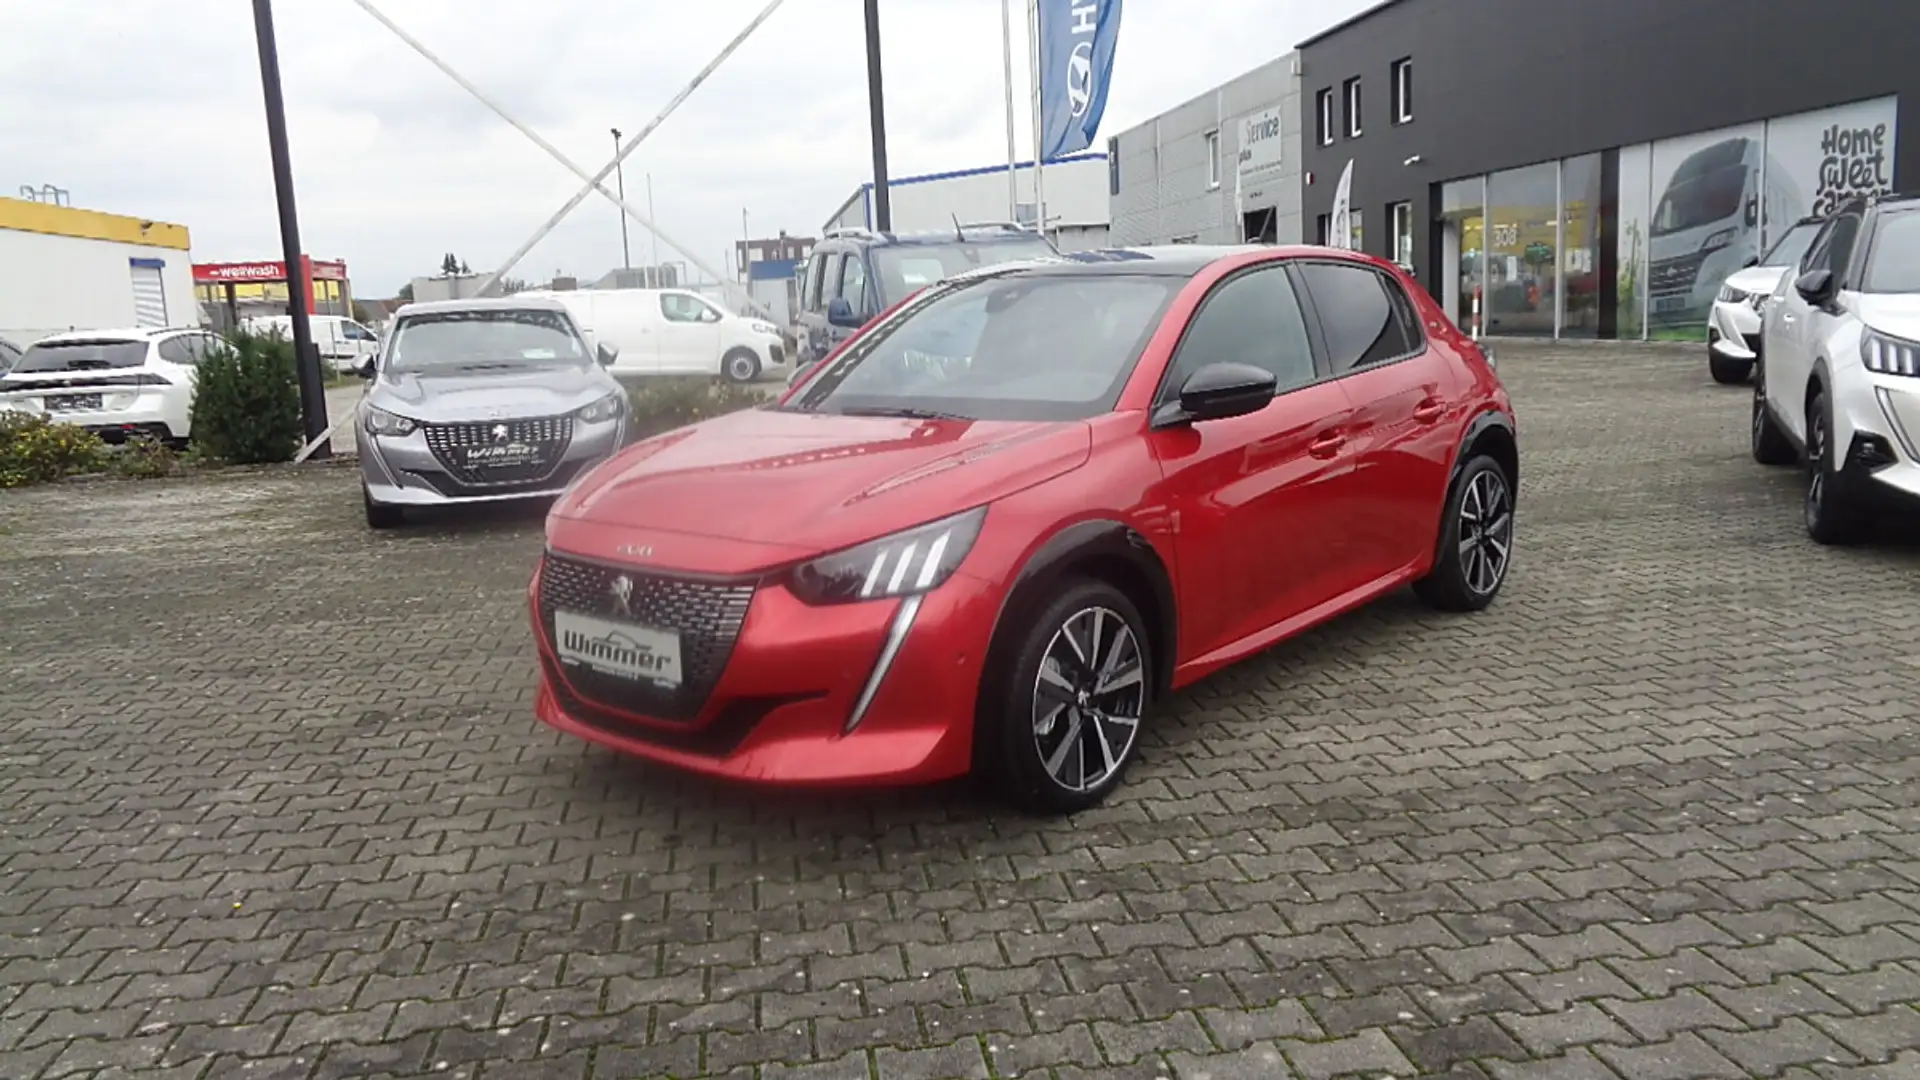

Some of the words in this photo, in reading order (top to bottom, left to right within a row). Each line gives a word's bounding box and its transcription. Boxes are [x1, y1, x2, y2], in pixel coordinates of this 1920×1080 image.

[1245, 112, 1280, 145] Service
[1821, 123, 1886, 156] Home
[564, 629, 672, 672] Wimmer
